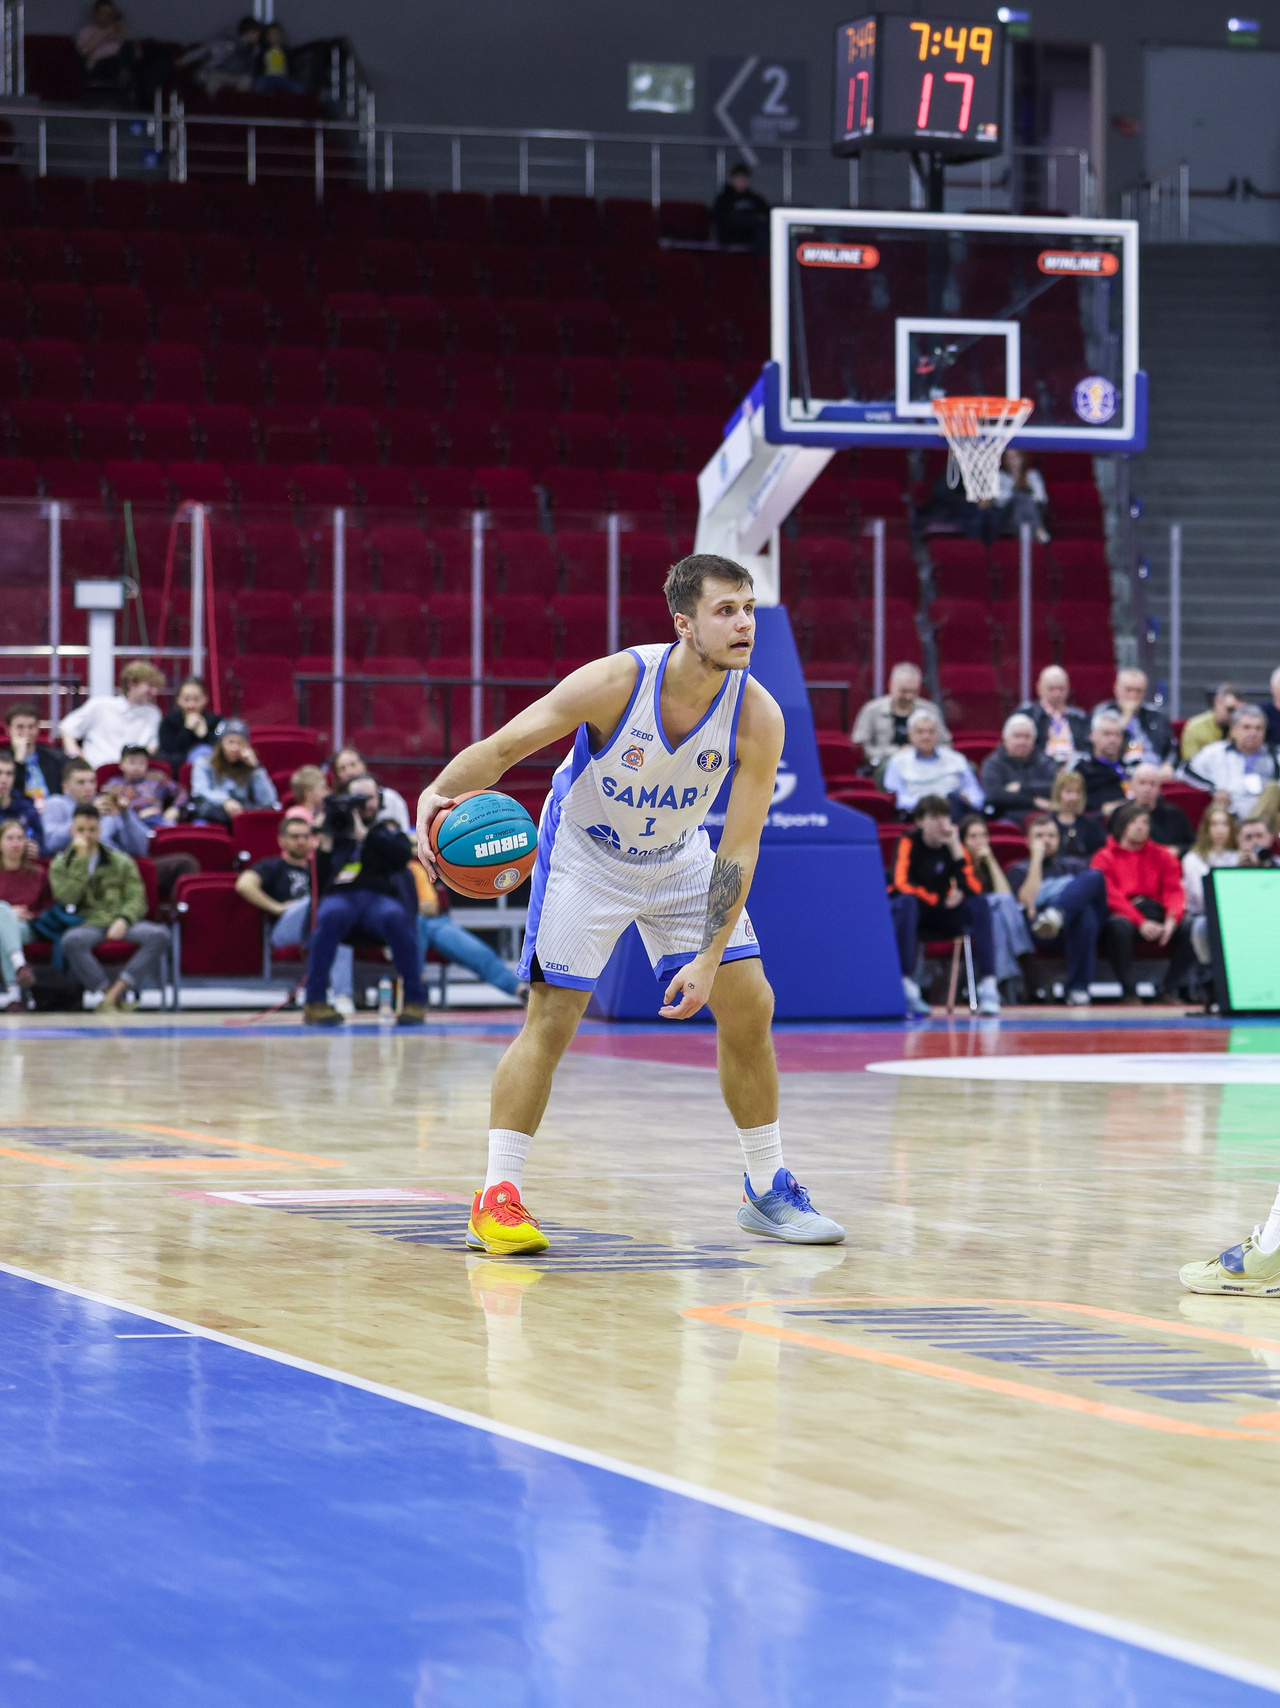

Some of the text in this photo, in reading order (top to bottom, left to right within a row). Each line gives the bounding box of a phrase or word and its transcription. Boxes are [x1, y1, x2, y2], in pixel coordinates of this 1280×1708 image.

[909, 22, 993, 65] 7:49
[761, 65, 789, 115] 2
[846, 70, 869, 130] 17
[917, 72, 975, 132] 17
[802, 248, 863, 264] WINLINE
[1043, 255, 1101, 271] WINLINE
[630, 728, 654, 742] ZEDO
[638, 817, 657, 837] 1
[474, 832, 528, 858] SIBUR
[545, 961, 569, 972] ZEDO
